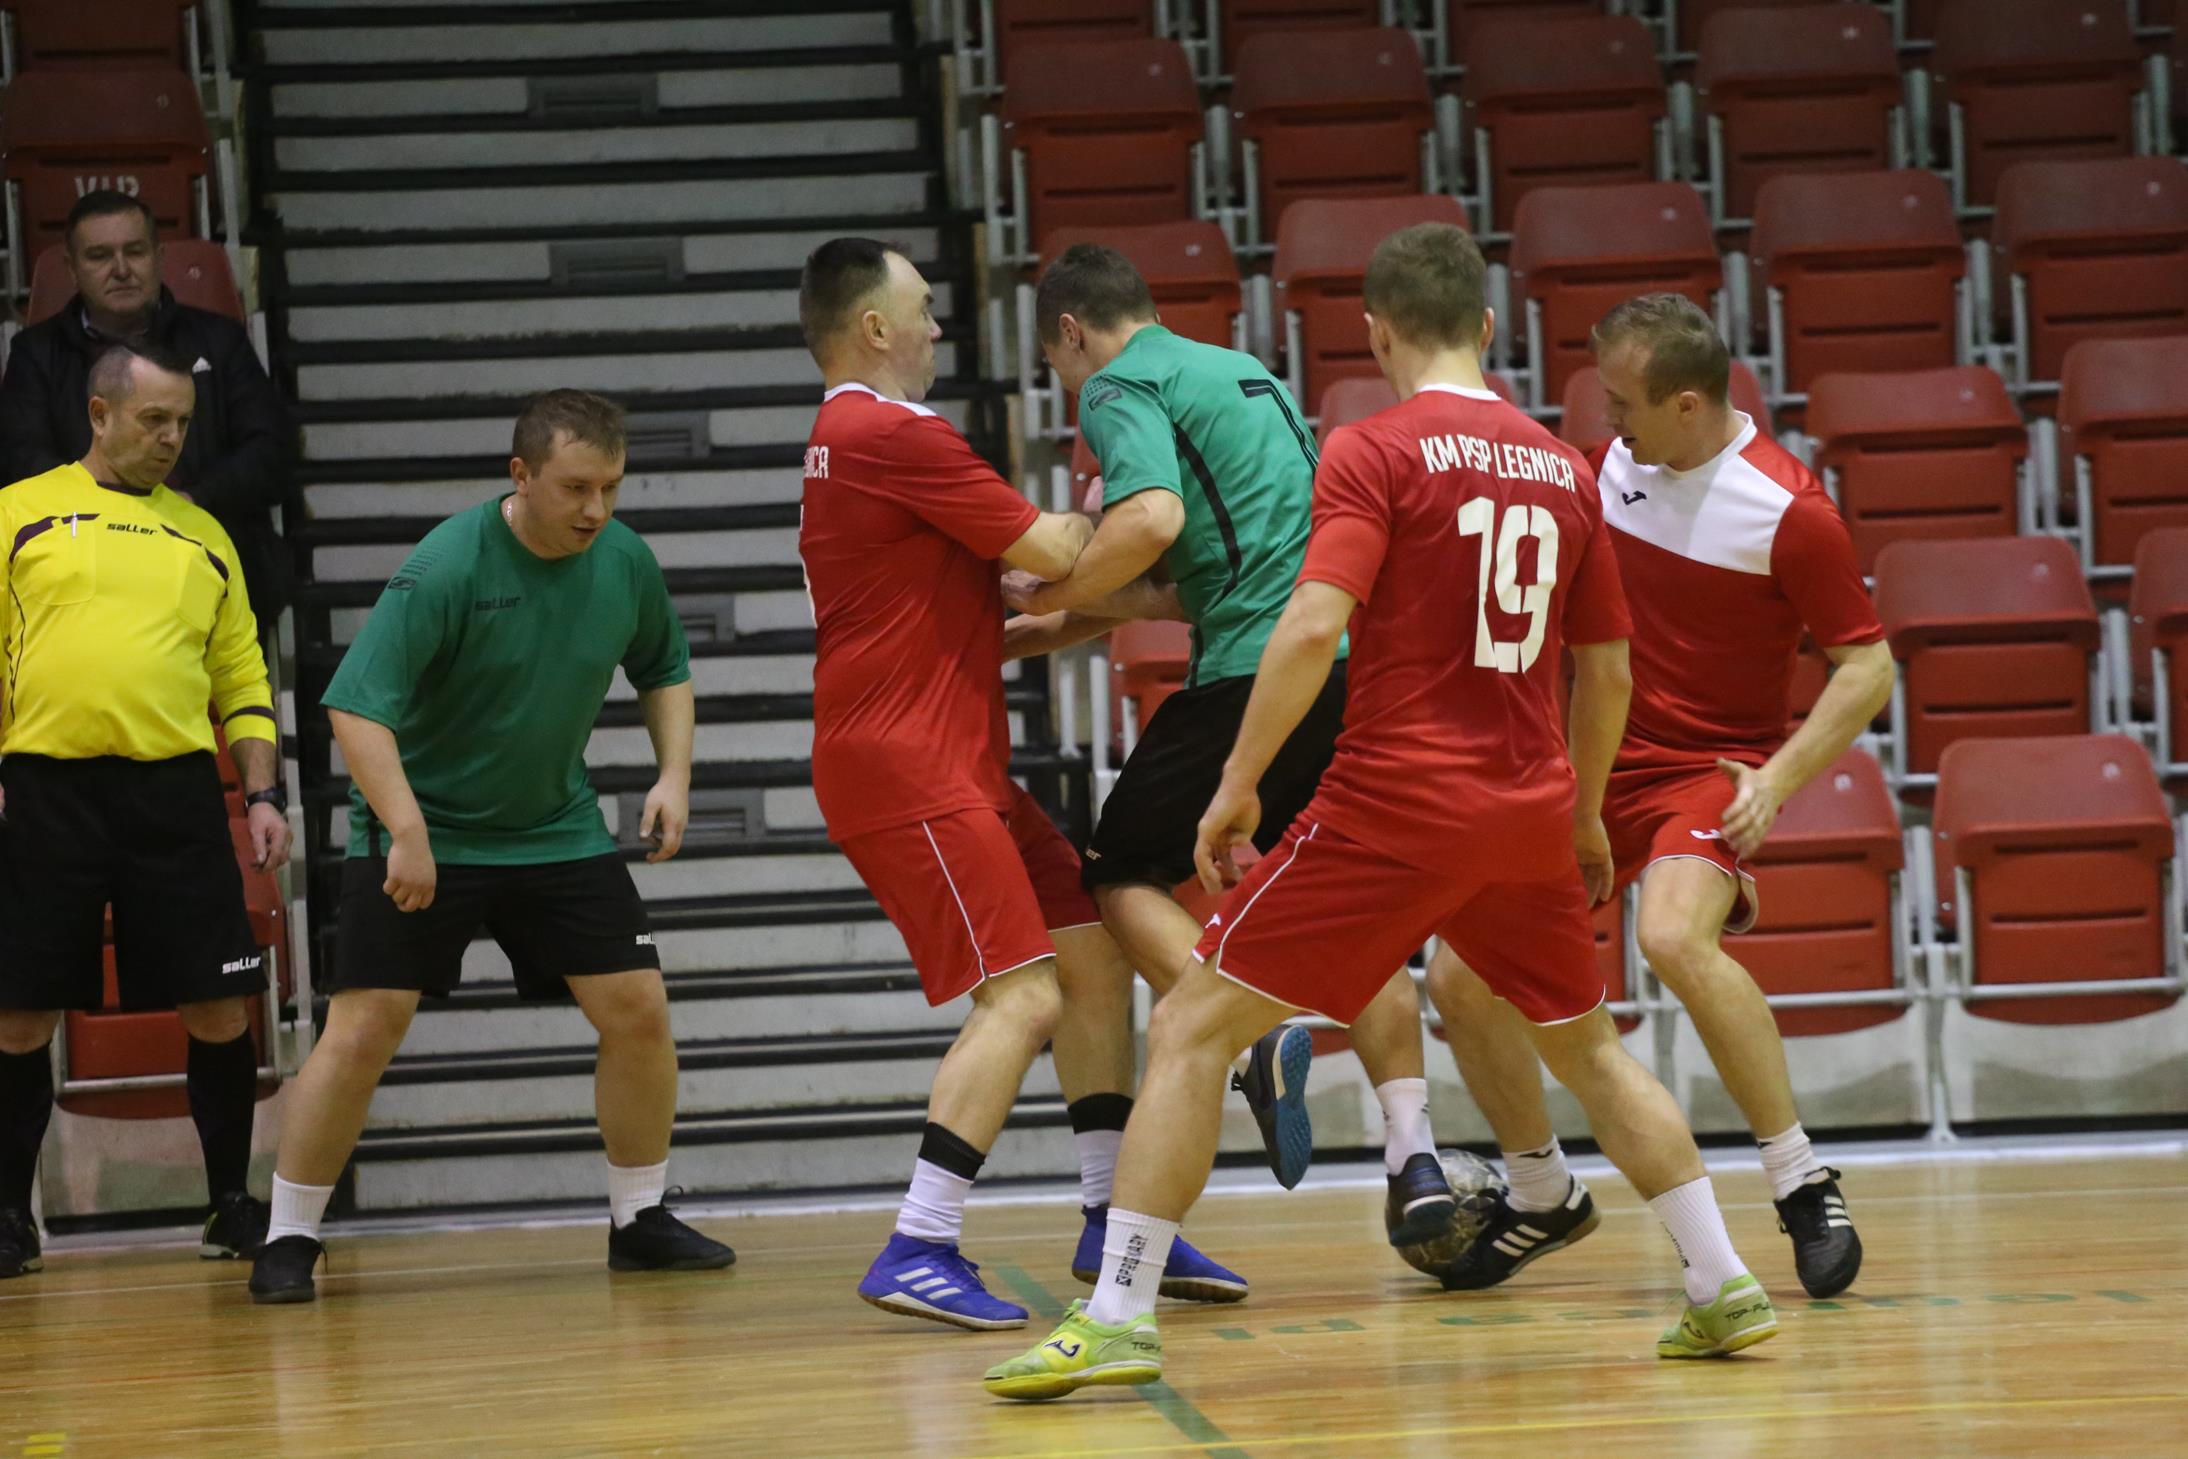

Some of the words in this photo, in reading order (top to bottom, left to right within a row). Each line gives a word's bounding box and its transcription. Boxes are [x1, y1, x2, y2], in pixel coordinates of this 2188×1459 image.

[1419, 434, 1462, 474] KM
[1457, 433, 1492, 474] PSP
[1493, 442, 1576, 493] LEGNICA
[1457, 496, 1559, 674] 19
